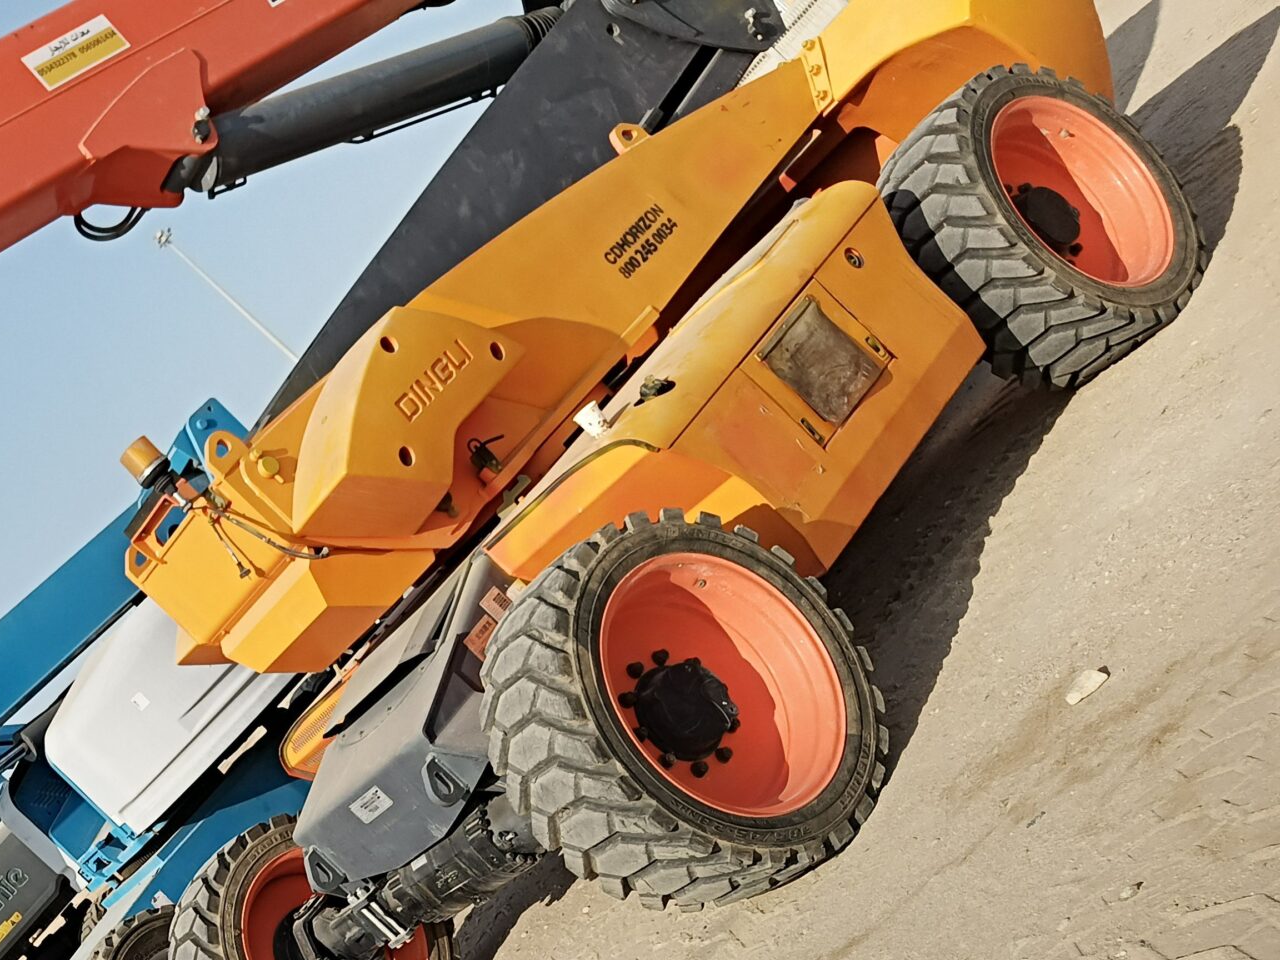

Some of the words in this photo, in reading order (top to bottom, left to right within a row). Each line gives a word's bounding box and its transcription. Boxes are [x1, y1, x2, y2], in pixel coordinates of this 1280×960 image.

[604, 204, 664, 264] CDHORIZON
[635, 238, 658, 263] 245
[652, 218, 678, 244] 0034
[393, 336, 475, 423] DINGLI
